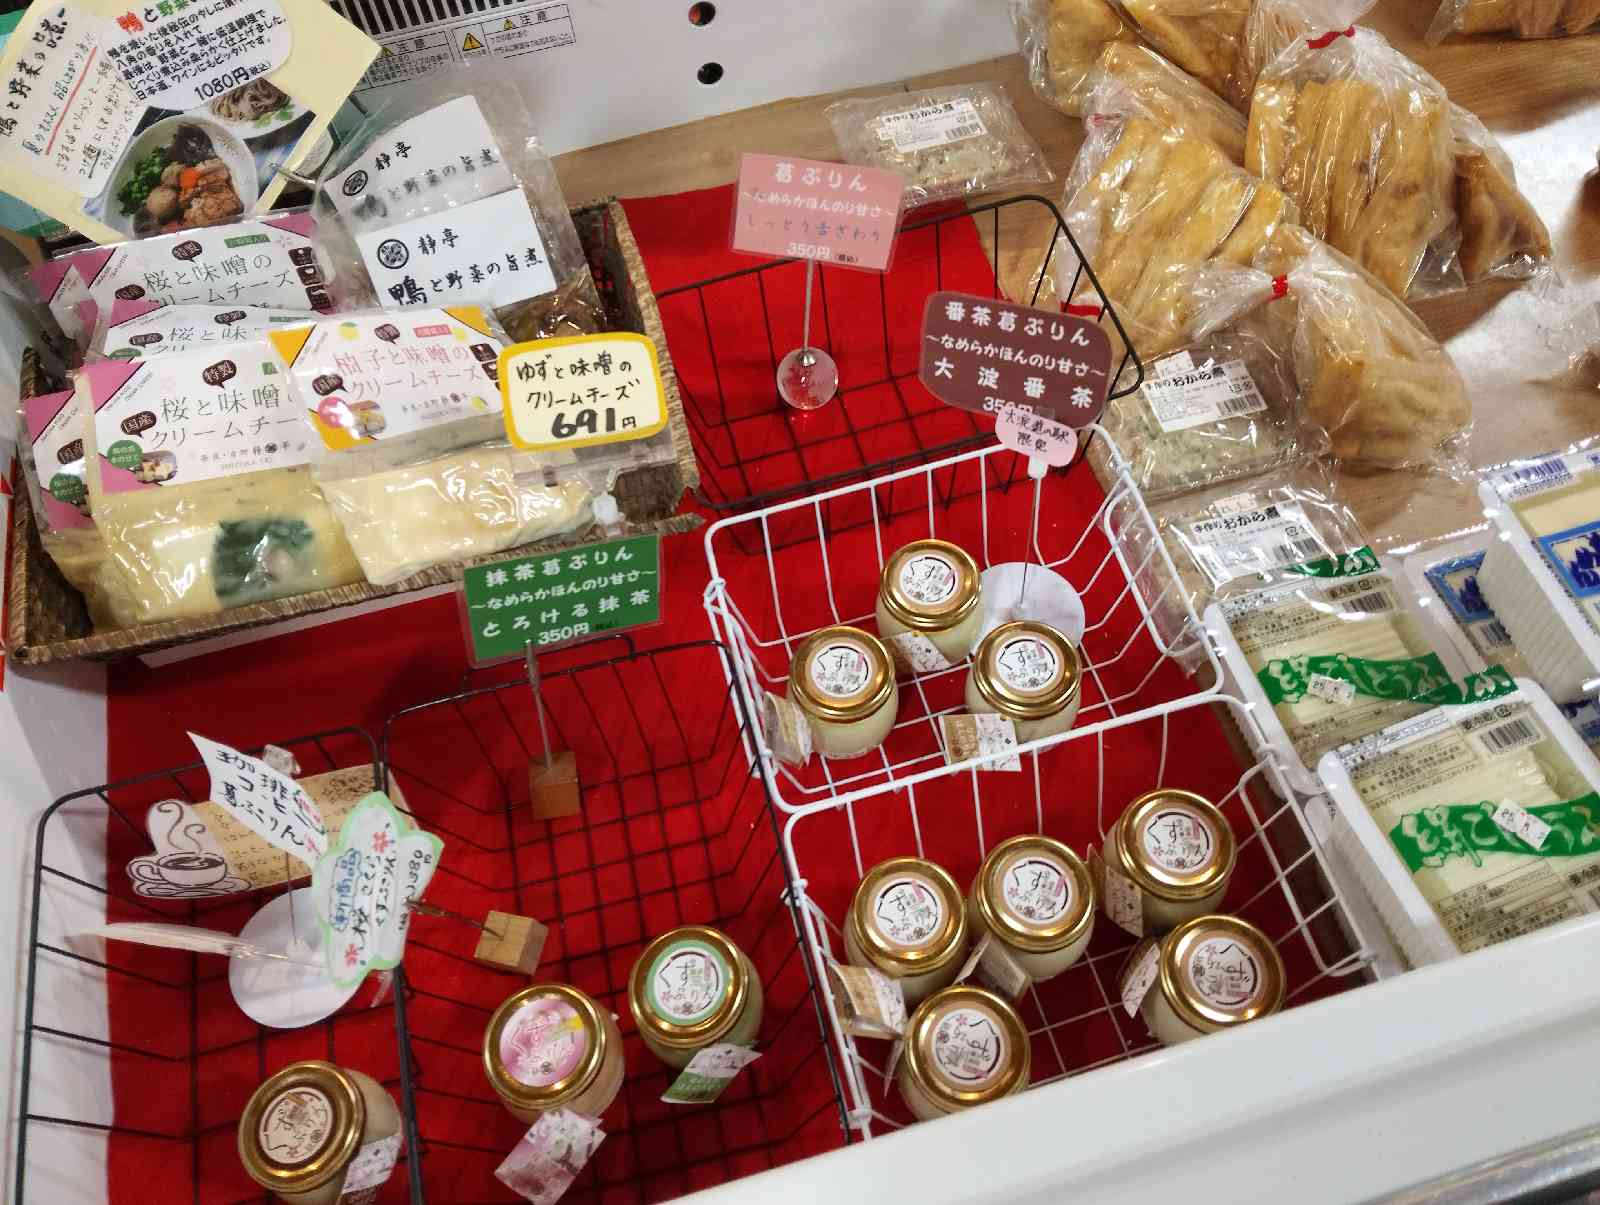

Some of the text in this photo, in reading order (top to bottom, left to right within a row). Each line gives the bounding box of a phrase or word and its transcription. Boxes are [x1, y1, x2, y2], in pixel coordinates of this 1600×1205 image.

[775, 161, 868, 192] 葛ぷりん
[785, 242, 832, 260] 350円
[944, 301, 1091, 347] 番茶葛ぷりん
[352, 364, 484, 400] クリームチーズ
[516, 350, 632, 383] ゆずと味噌の
[161, 383, 294, 424] 桜と味噌
[527, 378, 641, 409] クリームチーズ
[485, 546, 634, 588] 抹茶葛ぷりん
[482, 589, 651, 638] とろける抹茶
[538, 622, 590, 645] 350円
